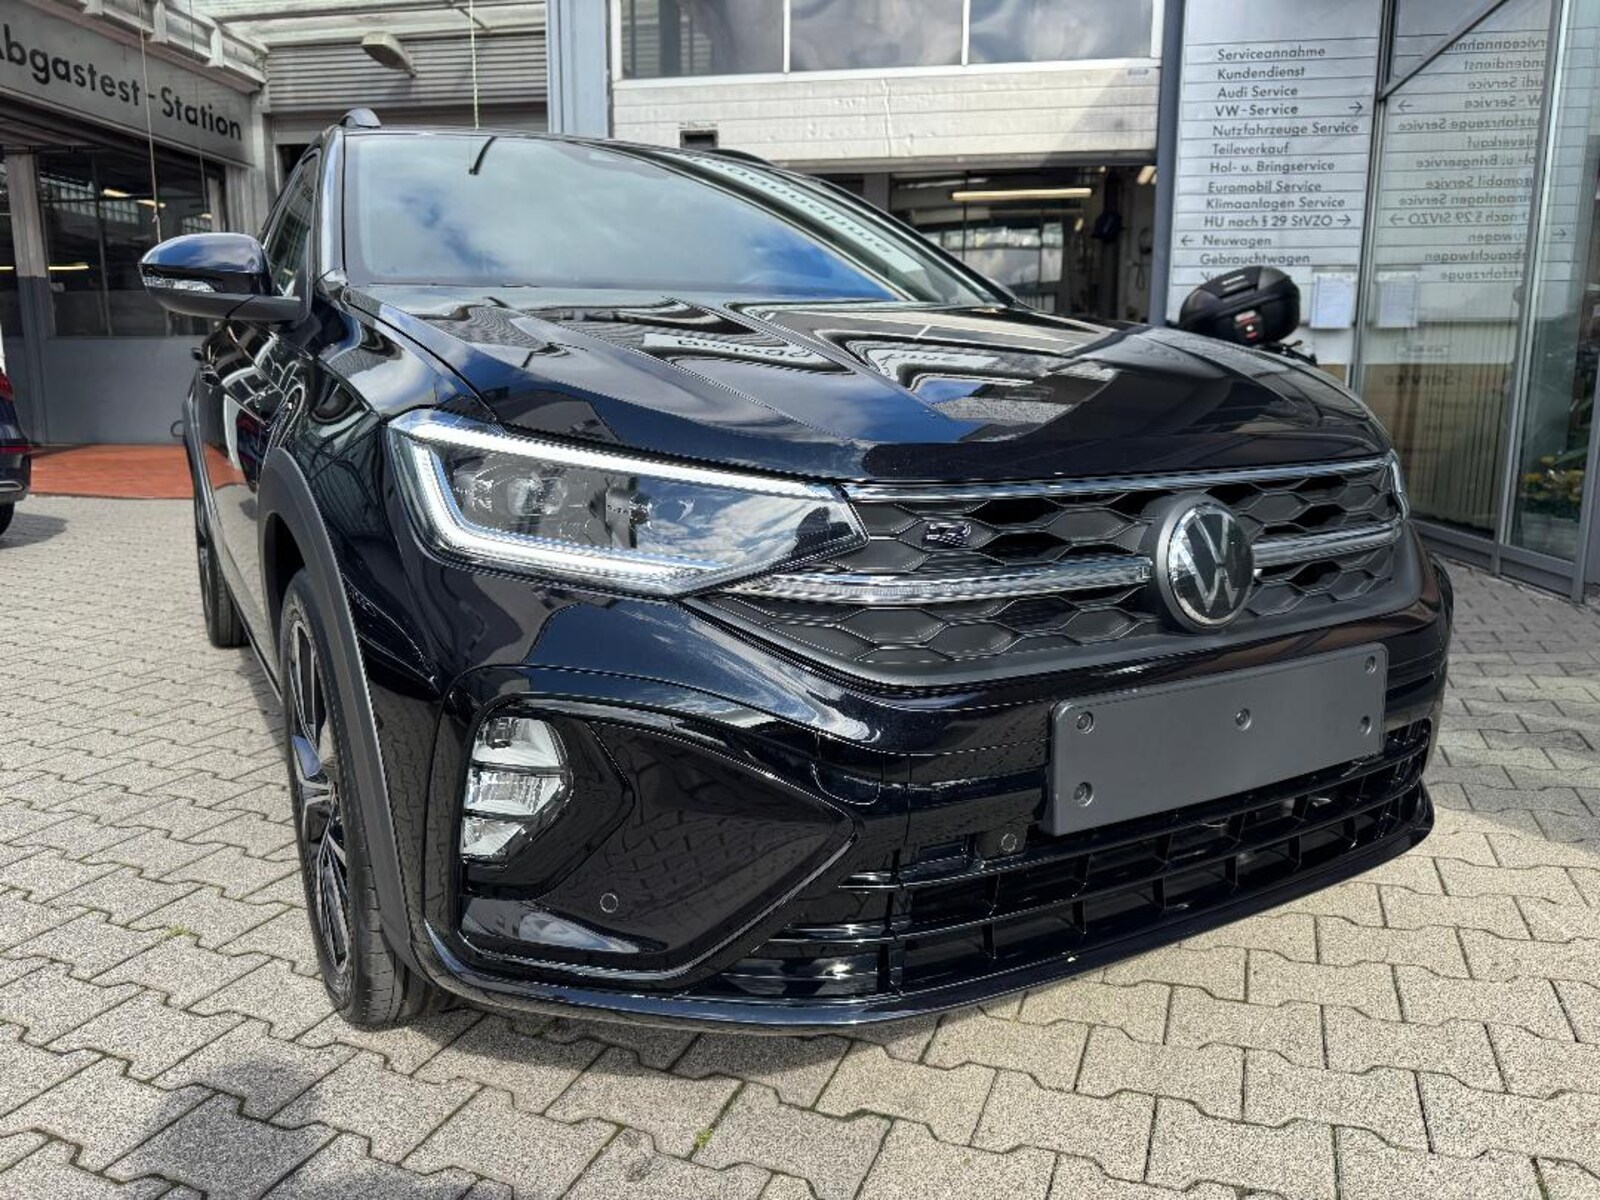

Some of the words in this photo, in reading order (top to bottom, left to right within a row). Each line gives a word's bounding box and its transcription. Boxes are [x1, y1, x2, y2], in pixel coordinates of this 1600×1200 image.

[1217, 44, 1326, 61] Serviceannahme
[1217, 66, 1306, 80] Kundendienst
[0, 23, 242, 142] bgastest-Station
[1217, 87, 1248, 99] Audi
[1251, 86, 1299, 98] Service
[1212, 123, 1308, 137] Nutzfahrzeuge
[1312, 122, 1359, 134] Service
[1212, 142, 1290, 155] Teileverkauf
[1210, 161, 1237, 173] Hol-
[1241, 163, 1253, 172] u.
[1257, 160, 1336, 174] Bringservice
[1208, 180, 1272, 194] Euromobil
[1276, 180, 1322, 192] Service
[1206, 198, 1295, 211] Klimaanlagen
[1299, 196, 1345, 208] Service
[1204, 216, 1224, 227] HU
[1228, 215, 1259, 227] nach
[1271, 215, 1287, 227] 29
[1291, 215, 1333, 227] StVZO
[1202, 235, 1272, 248] Neuwagen
[1200, 252, 1311, 266] Gebrauchtwagen
